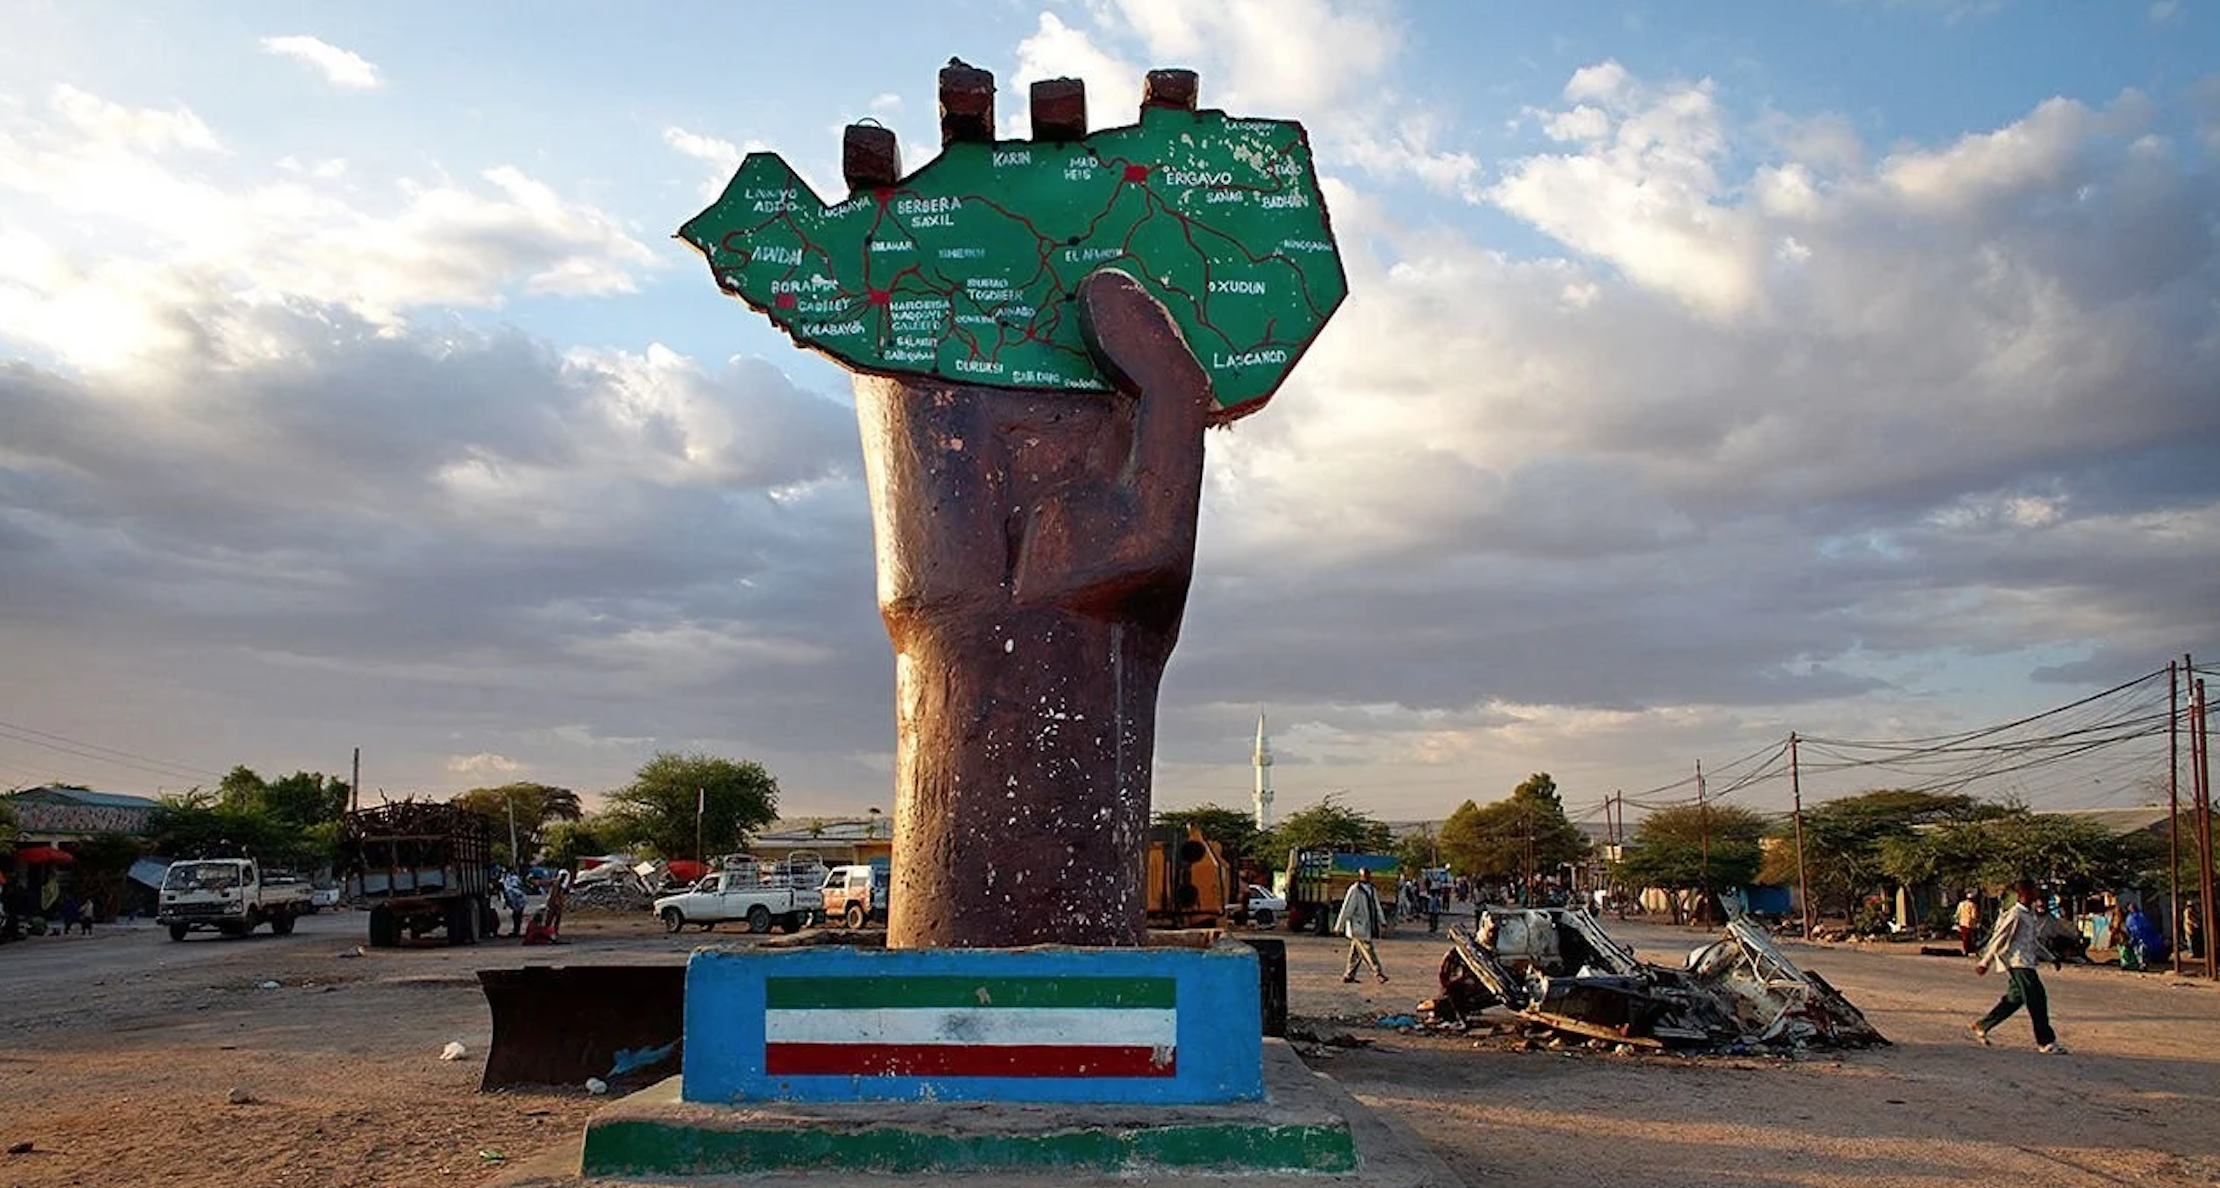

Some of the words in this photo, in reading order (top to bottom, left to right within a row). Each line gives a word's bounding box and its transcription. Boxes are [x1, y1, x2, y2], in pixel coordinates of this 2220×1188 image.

[993, 151, 1031, 167] KARIN
[1166, 172, 1232, 185] ERIGAVO
[897, 197, 962, 214] BERBERA
[911, 214, 954, 227] SAXIL
[1218, 281, 1266, 295] XUDUN
